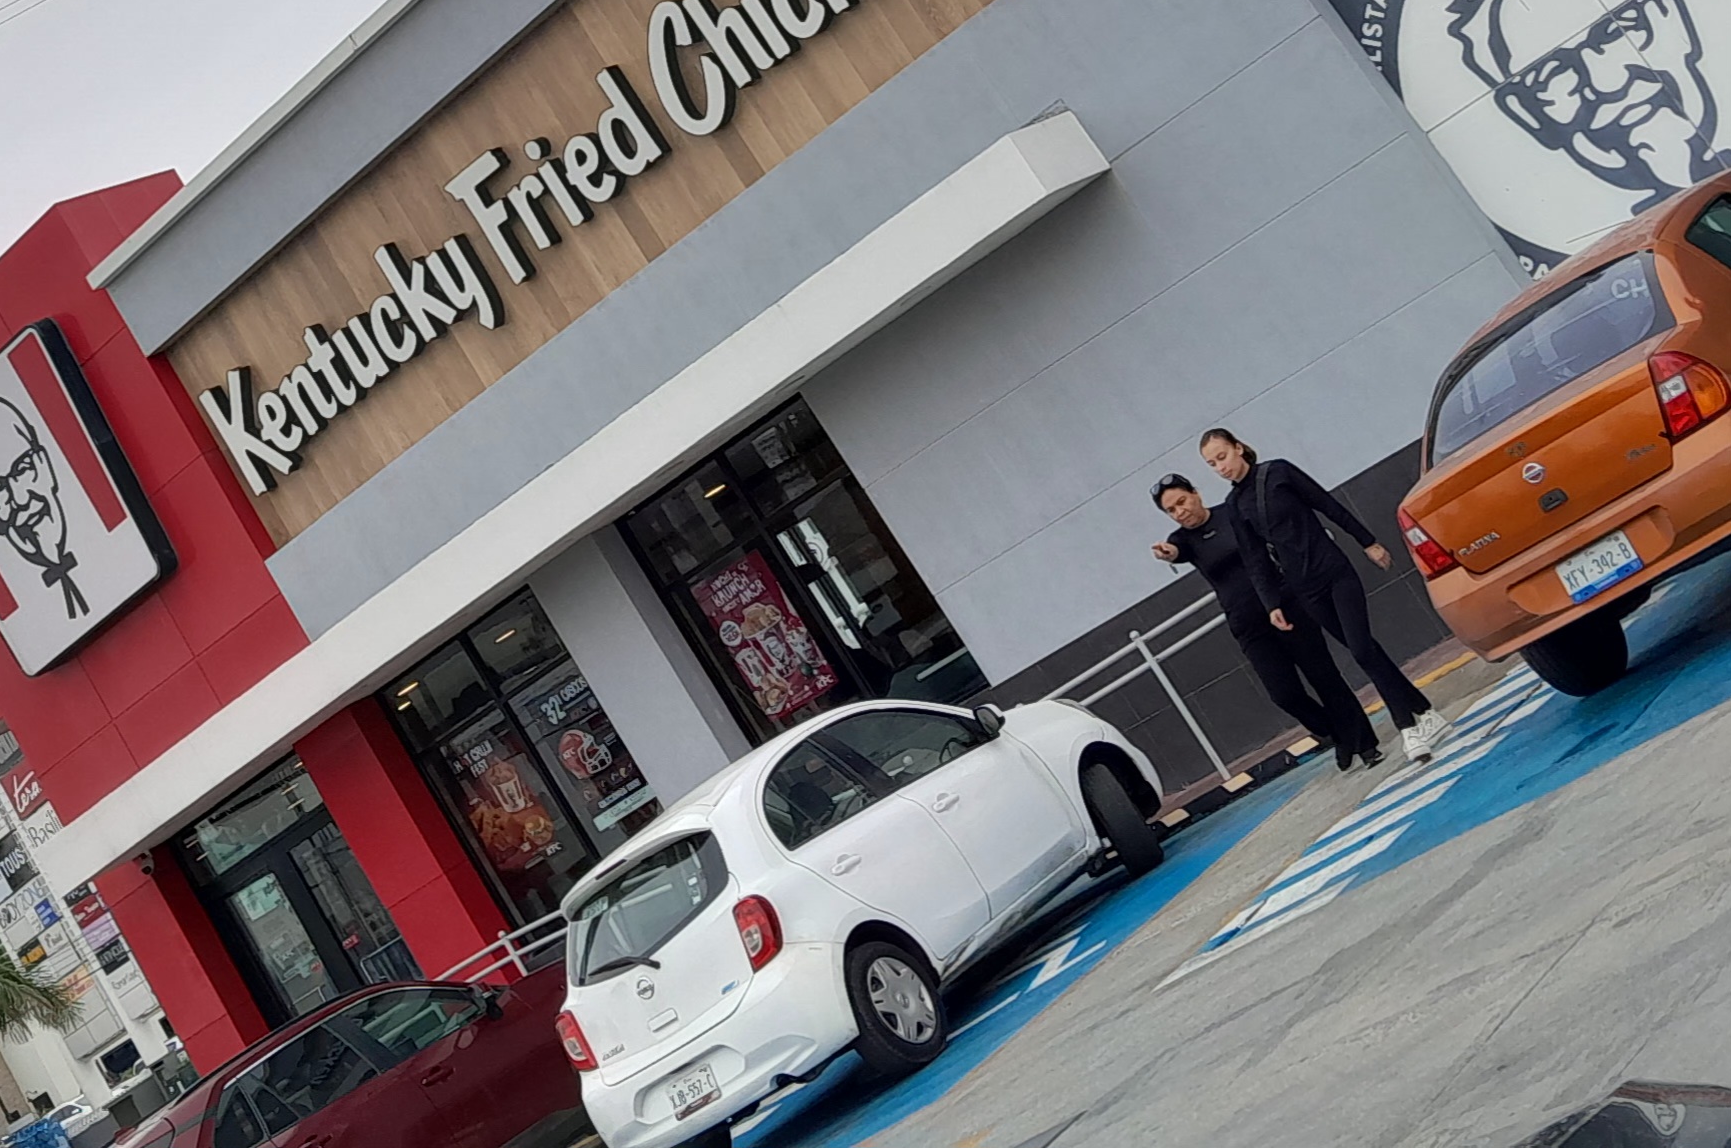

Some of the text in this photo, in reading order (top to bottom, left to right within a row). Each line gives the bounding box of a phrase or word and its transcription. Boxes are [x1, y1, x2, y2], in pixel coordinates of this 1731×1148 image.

[199, 233, 506, 497] Kentucky
[444, 65, 672, 285] Fried
[1563, 541, 1632, 591] XFY-342-B
[0, 847, 26, 877] TOUS
